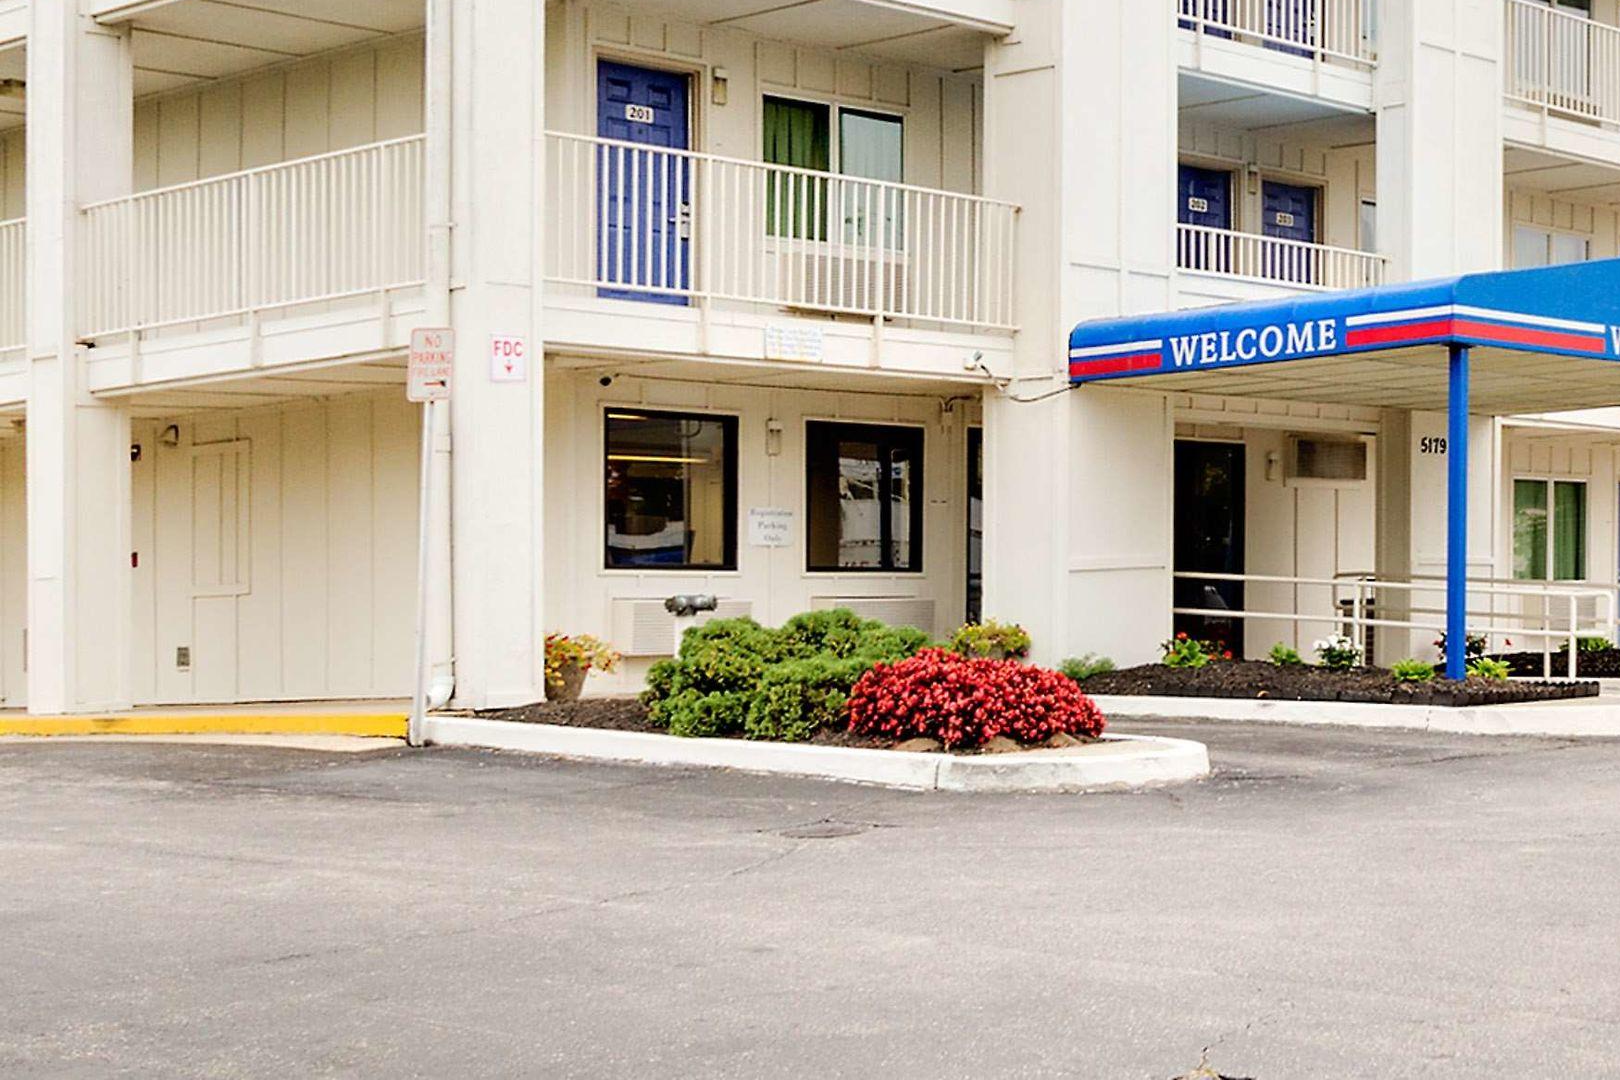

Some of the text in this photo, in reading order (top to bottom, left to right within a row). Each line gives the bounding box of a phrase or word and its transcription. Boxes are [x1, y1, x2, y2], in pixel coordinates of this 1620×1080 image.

[630, 107, 650, 121] 201
[425, 334, 442, 348] NO
[493, 340, 524, 357] FDC
[1169, 319, 1337, 367] WELCOME
[1421, 436, 1447, 453] 5179
